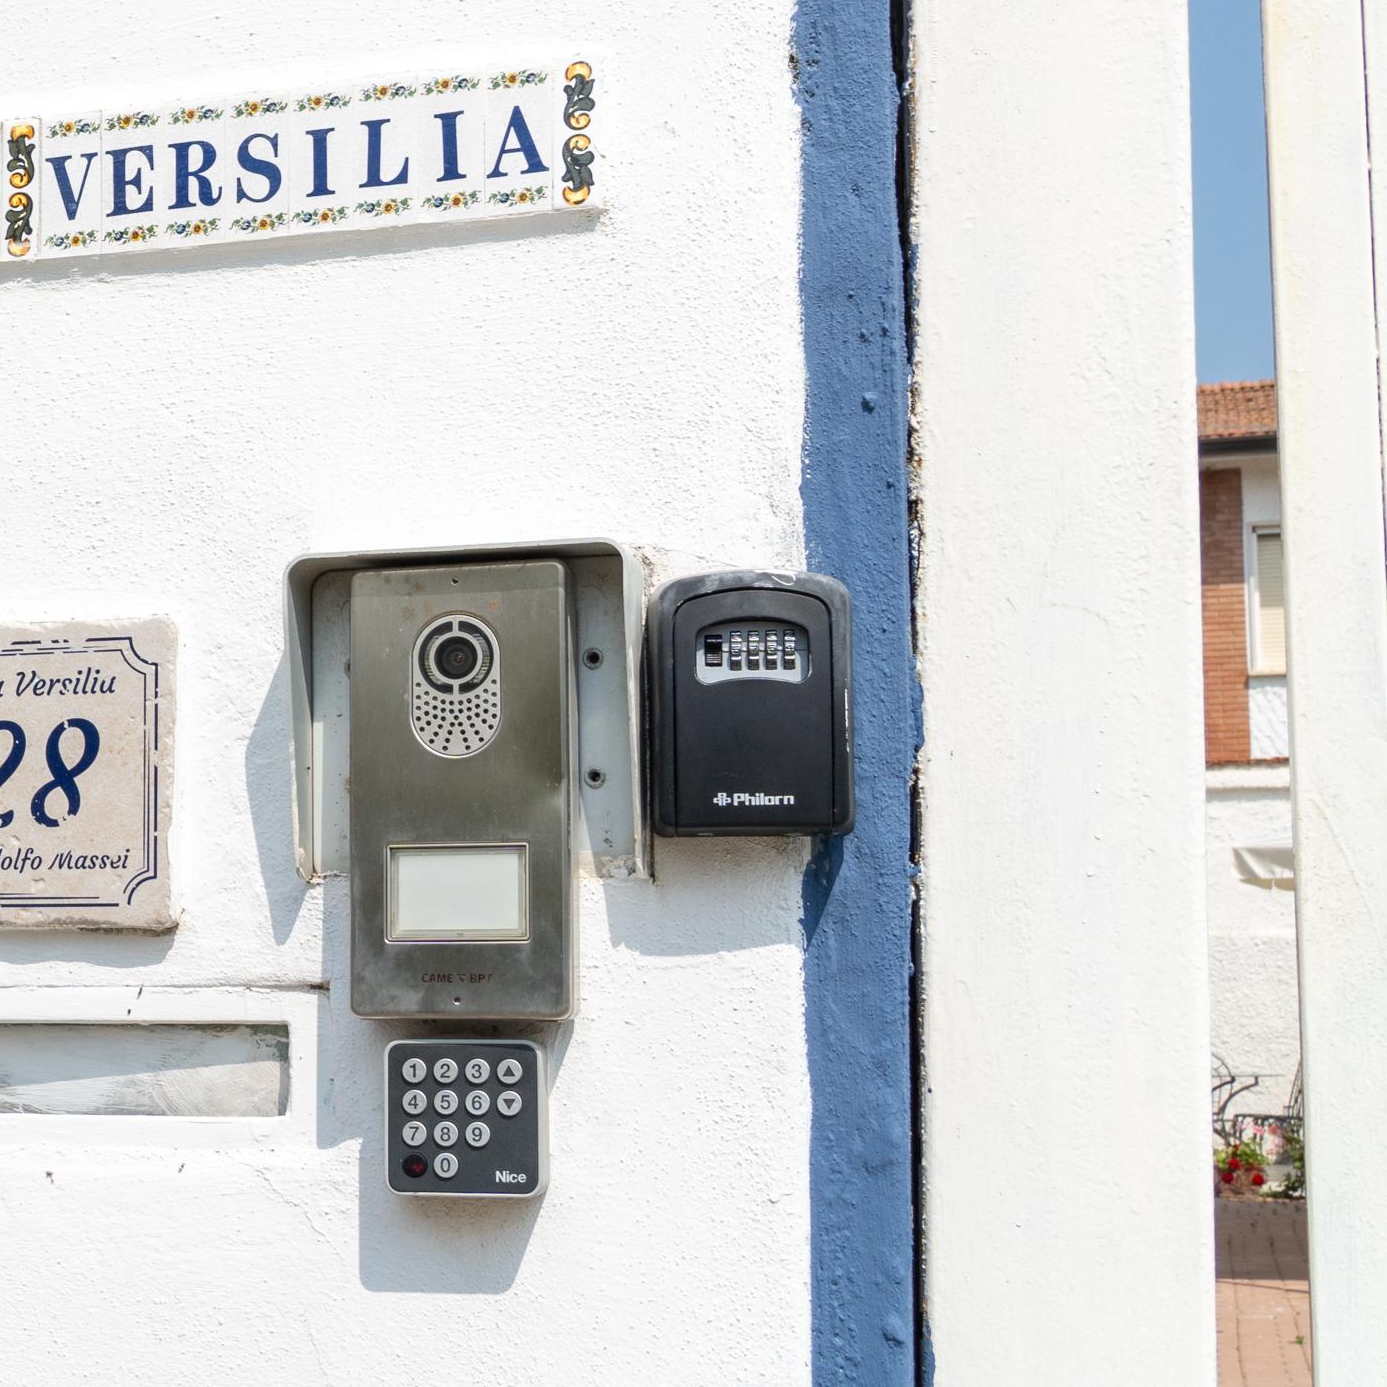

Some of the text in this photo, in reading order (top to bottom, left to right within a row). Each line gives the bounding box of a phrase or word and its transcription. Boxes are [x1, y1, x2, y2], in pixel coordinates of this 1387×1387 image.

[46, 104, 550, 222] VERSILIA
[733, 792, 795, 806] Philorn
[47, 848, 131, 872] Massei
[408, 1062, 483, 1080] 1 2 3
[407, 1094, 483, 1111] 4 5 6
[408, 1126, 483, 1143] 7 8 9
[440, 1157, 451, 1173] 0
[495, 1170, 527, 1183] Nice
